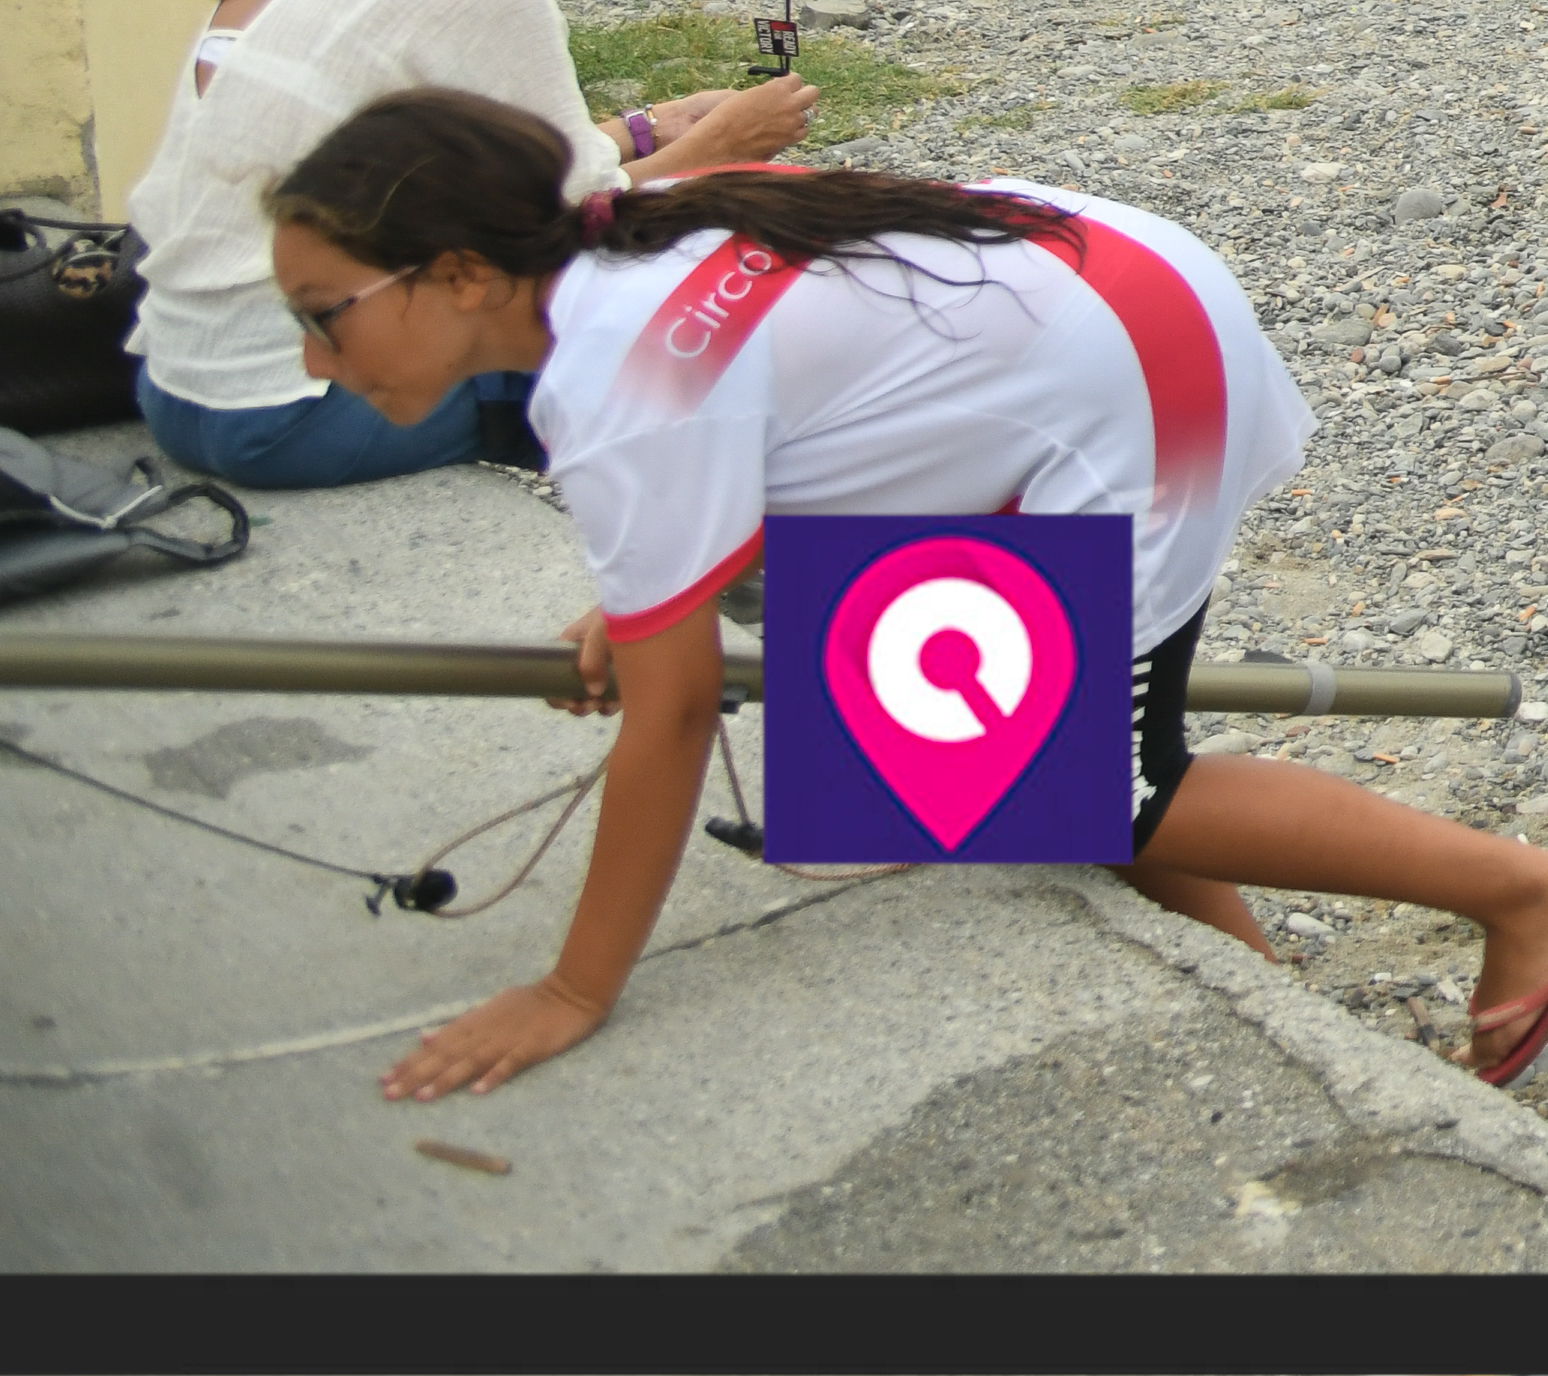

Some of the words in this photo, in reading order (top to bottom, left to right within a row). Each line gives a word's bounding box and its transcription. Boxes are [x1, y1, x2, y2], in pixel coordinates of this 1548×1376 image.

[757, 20, 774, 54] VICTORY
[783, 30, 797, 56] READY
[665, 250, 773, 359] Circo
